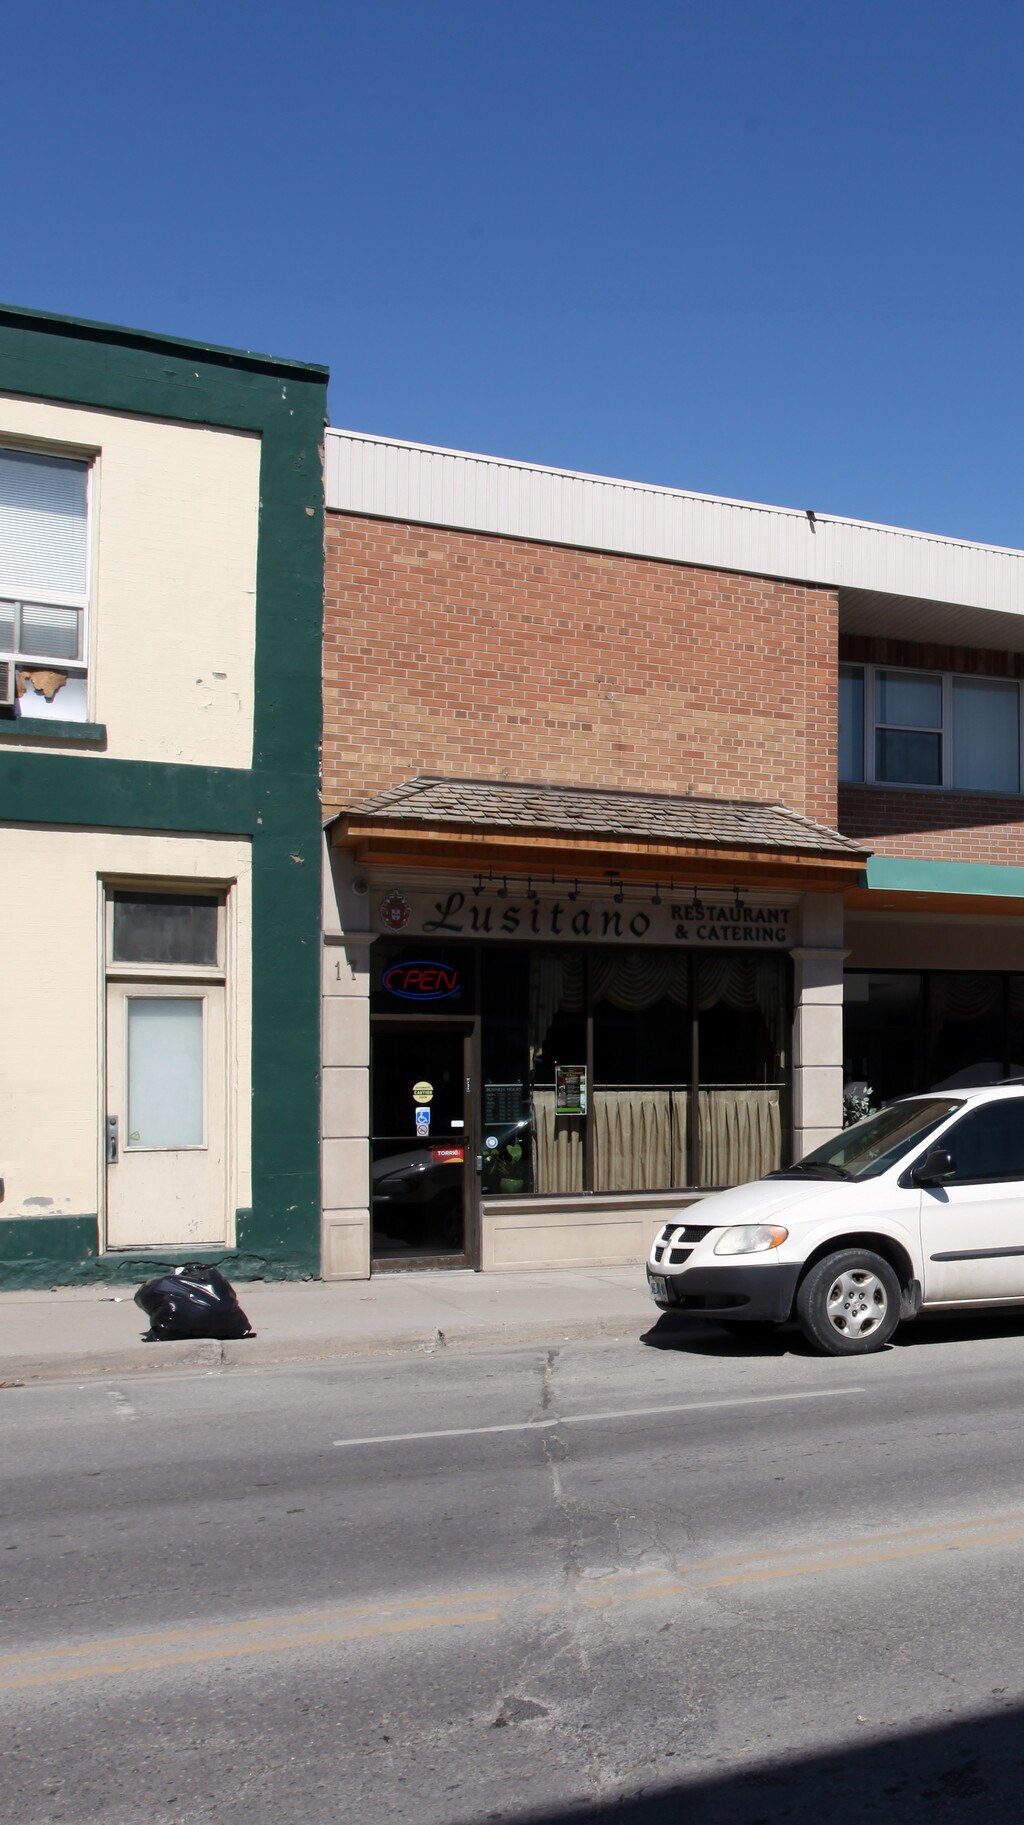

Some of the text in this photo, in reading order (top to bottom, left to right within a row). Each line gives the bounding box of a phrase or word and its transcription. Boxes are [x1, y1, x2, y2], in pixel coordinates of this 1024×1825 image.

[422, 891, 651, 938] Lusitano
[671, 904, 791, 924] RESTAURANT
[674, 924, 787, 943] & CATERING
[334, 960, 357, 981] 17
[385, 969, 459, 990] OPEN
